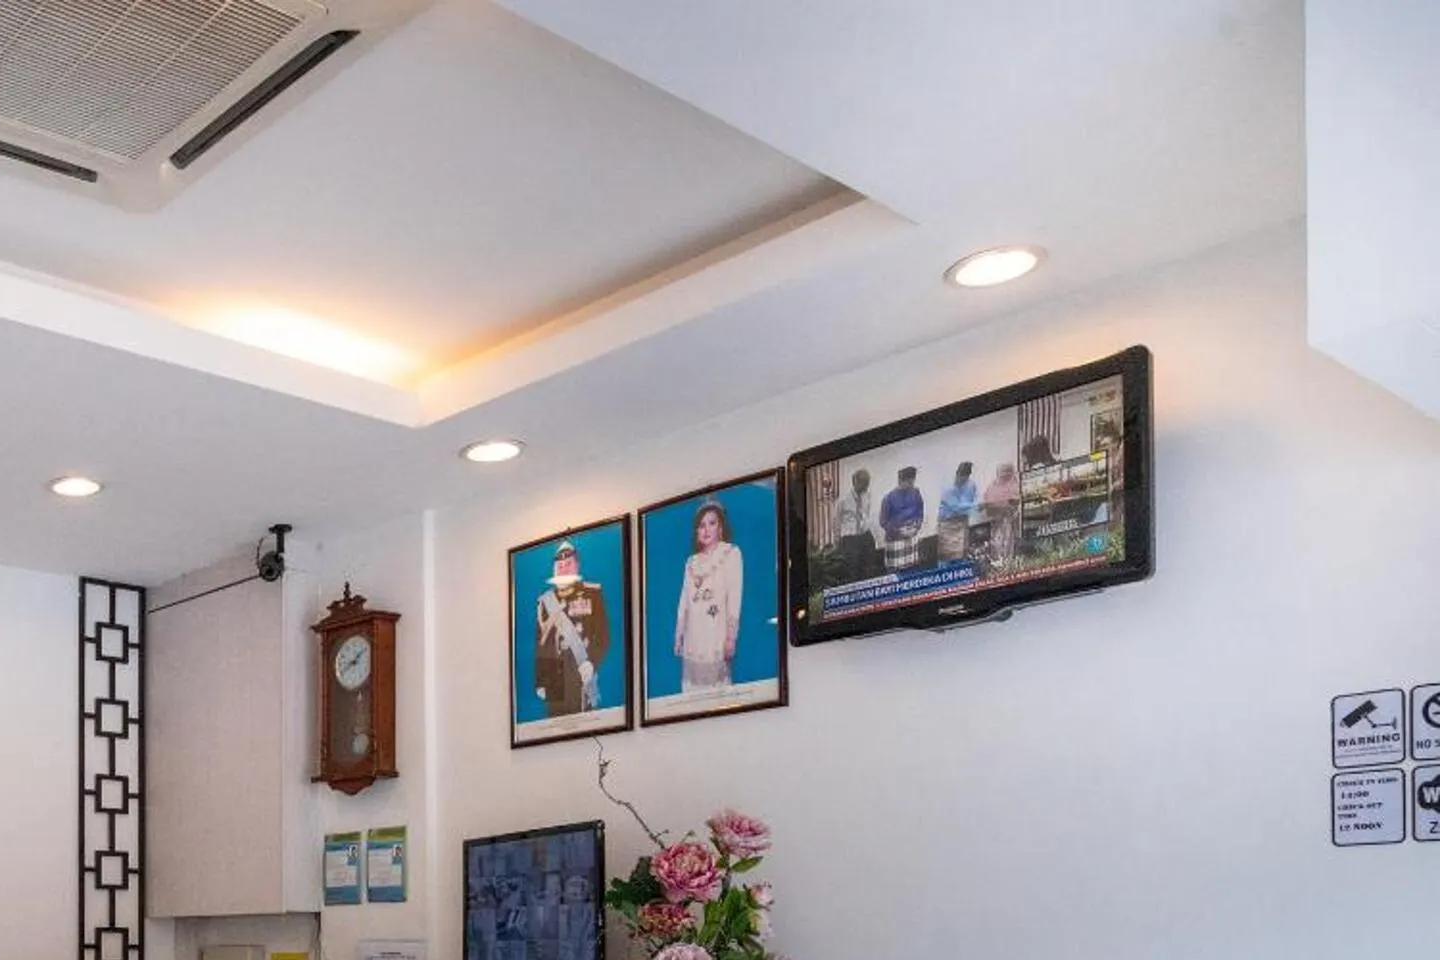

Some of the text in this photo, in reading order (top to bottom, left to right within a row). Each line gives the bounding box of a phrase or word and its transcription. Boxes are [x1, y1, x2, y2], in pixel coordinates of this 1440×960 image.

[1337, 733, 1401, 747] WARNING
[1416, 739, 1432, 749] NO
[1353, 822, 1382, 831] NOON
